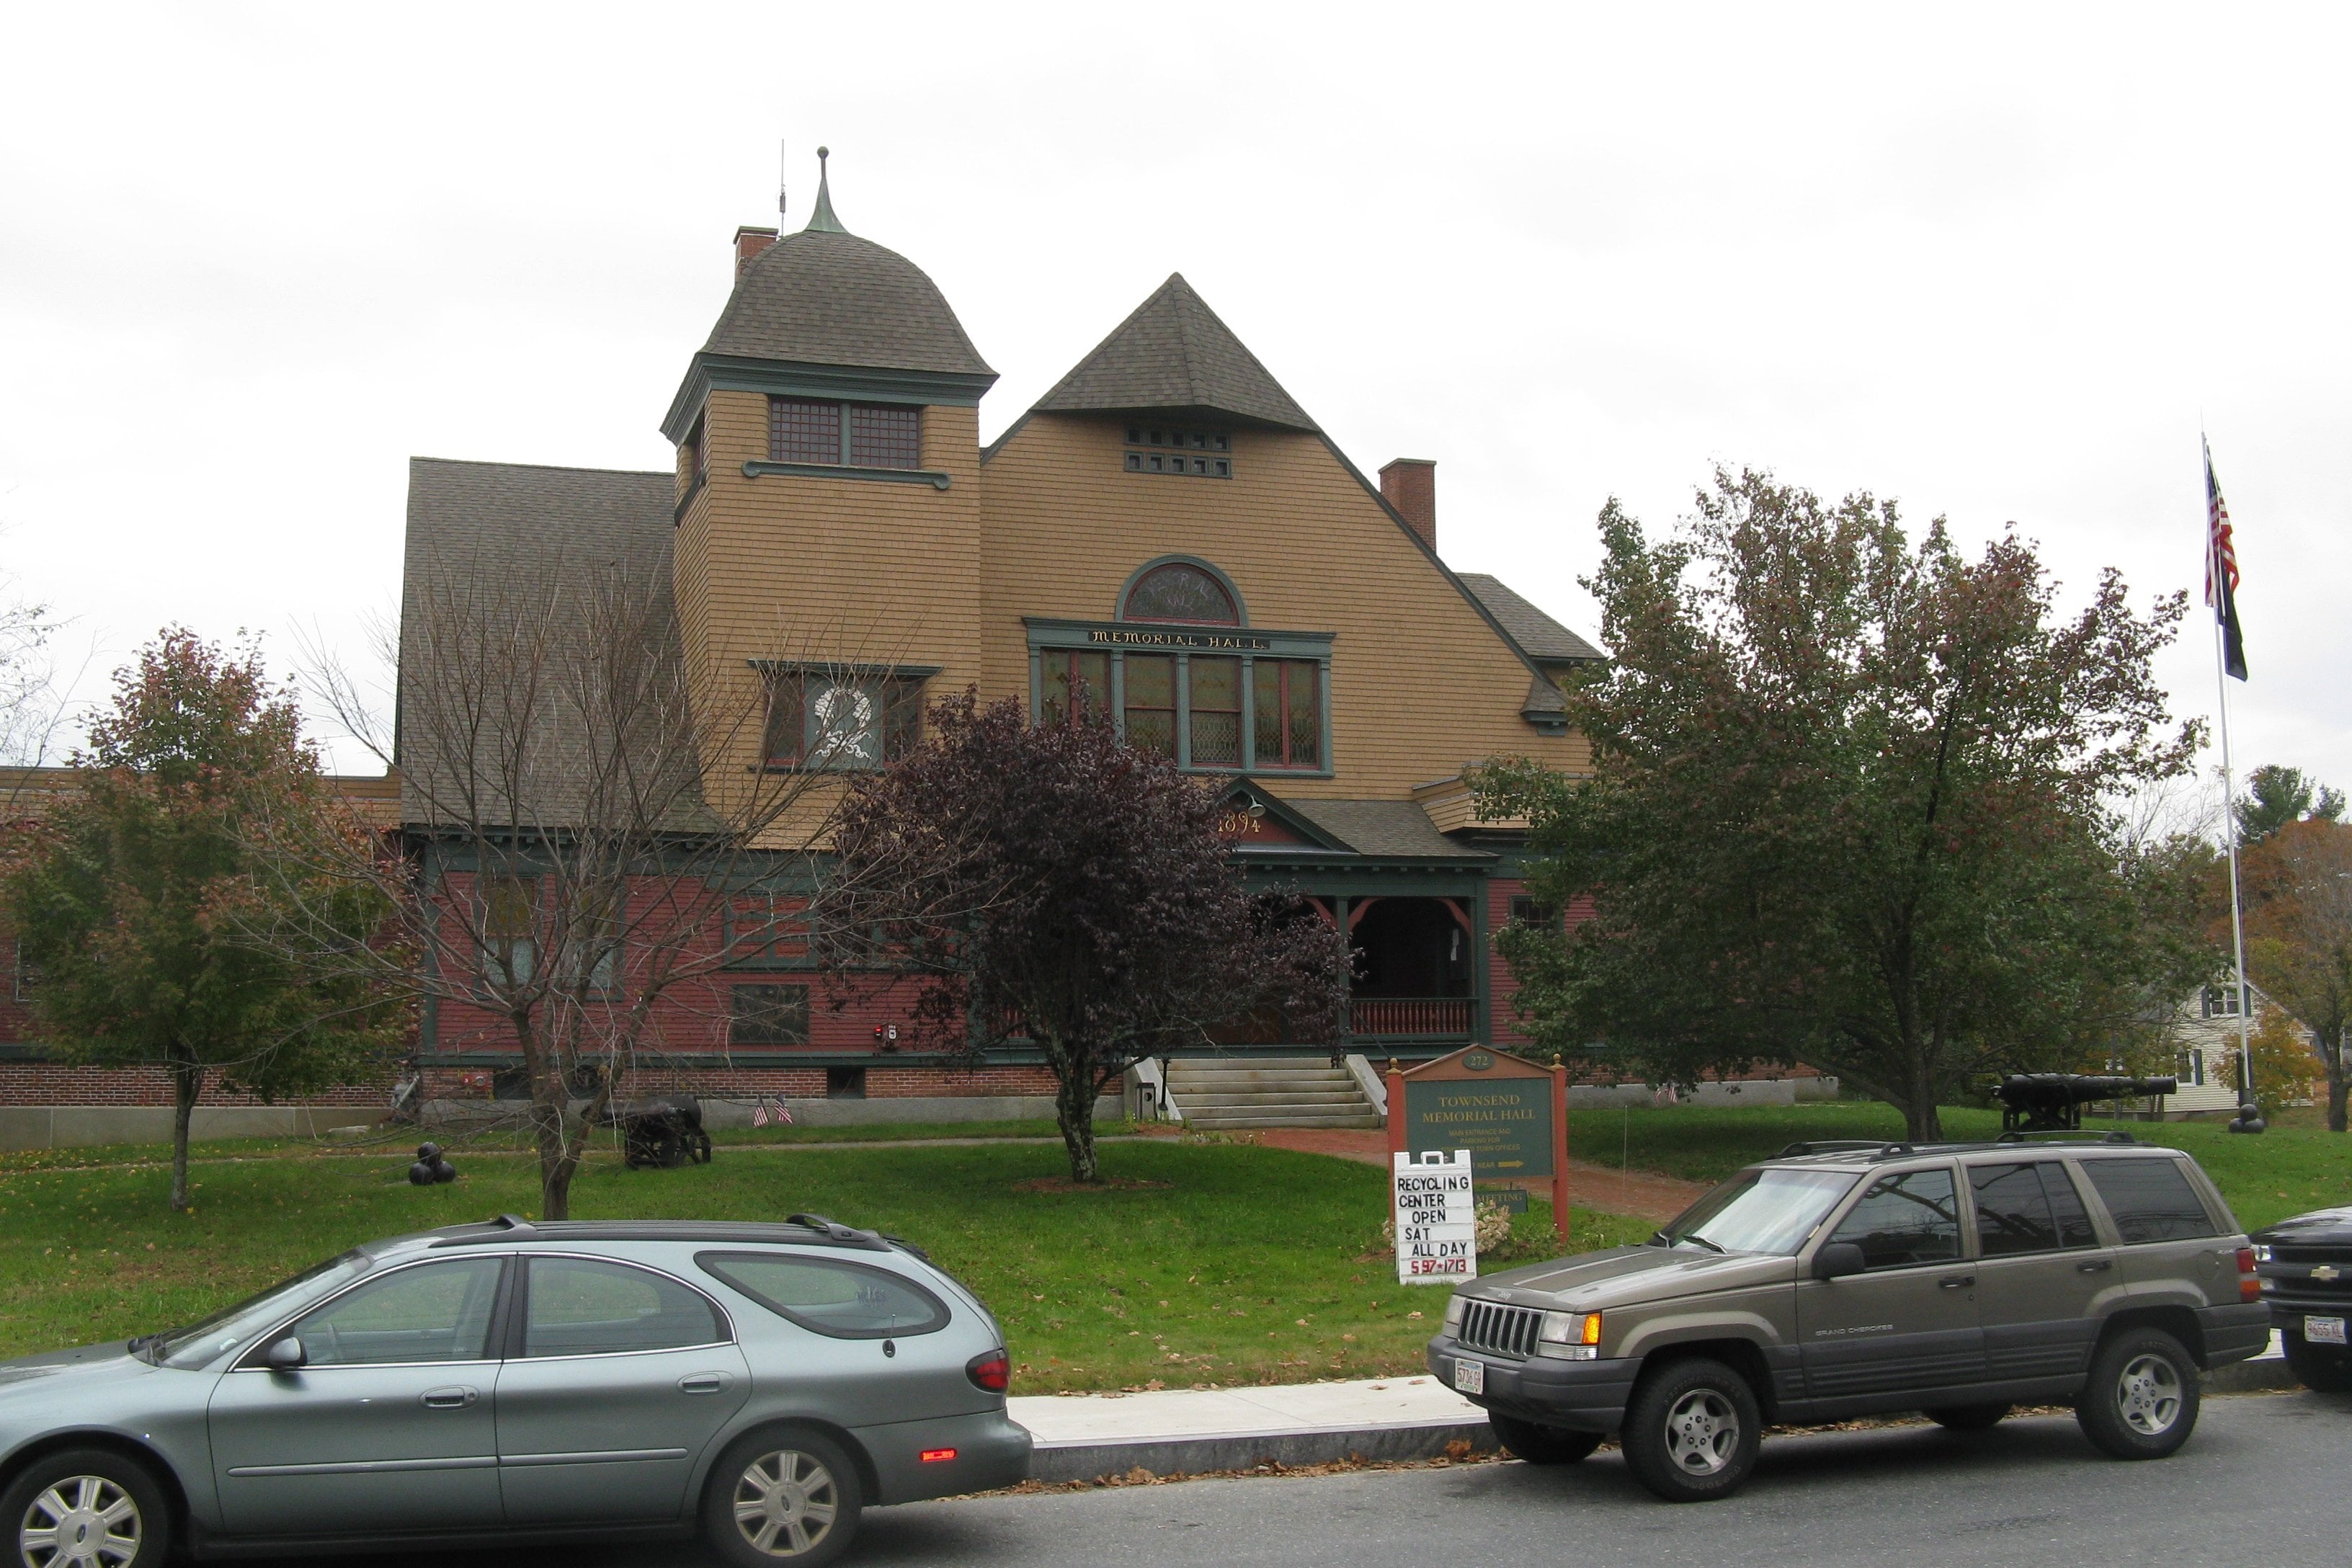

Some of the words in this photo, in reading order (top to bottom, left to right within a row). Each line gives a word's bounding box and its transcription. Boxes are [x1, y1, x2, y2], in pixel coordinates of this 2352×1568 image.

[1092, 631, 1198, 646] MEMORIAL
[1217, 811, 1260, 834] 1894
[1471, 1056, 1488, 1066] 272
[1438, 1095, 1520, 1107] TOWNSEND
[1422, 1111, 1497, 1123] MEMORIAL
[1501, 1109, 1536, 1120] HALL
[1398, 1177, 1469, 1191] RECYCLING
[1399, 1193, 1445, 1208] CENTER
[1476, 1194, 1522, 1203] MEETING
[1412, 1209, 1446, 1224] OPEN
[1405, 1227, 1430, 1240] SAT
[1412, 1244, 1434, 1256] ALL
[1440, 1242, 1467, 1256] DAY
[1848, 1324, 1893, 1333] CHEROKEE
